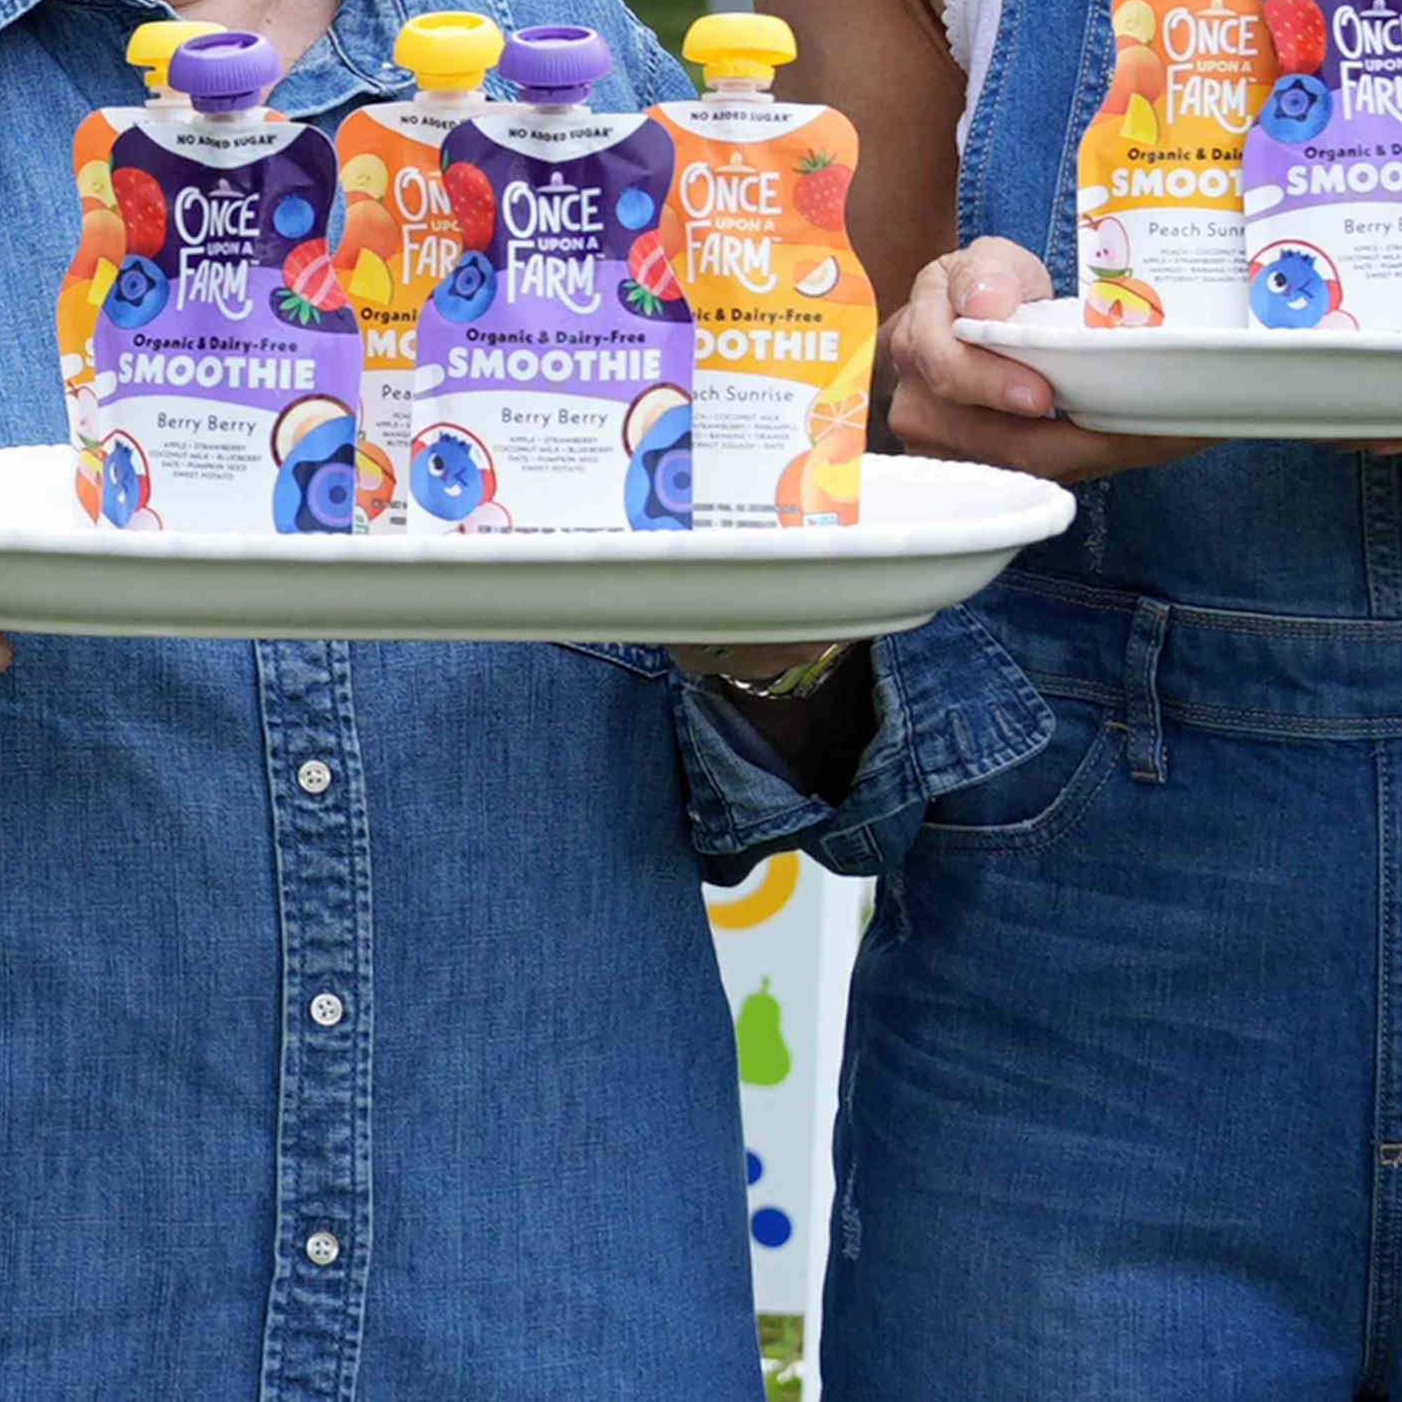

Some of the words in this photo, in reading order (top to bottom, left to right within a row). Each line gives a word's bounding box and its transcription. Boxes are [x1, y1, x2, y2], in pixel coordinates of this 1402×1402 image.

[1162, 7, 1259, 62] ONCE
[1197, 59, 1239, 72] UPON
[1241, 60, 1252, 72] A
[400, 115, 418, 125] NO
[690, 112, 709, 121] NO
[712, 111, 747, 122] ADDED
[177, 134, 195, 145] NO
[509, 128, 526, 139] NO
[1127, 148, 1191, 163] Organic
[1196, 148, 1207, 160] &
[1304, 144, 1371, 162] Organic
[1377, 144, 1387, 157] &
[679, 161, 783, 219] ONCE
[1111, 167, 1246, 199] SMOOT
[394, 166, 452, 222] ON
[174, 186, 260, 245] ONCE
[501, 180, 604, 238] ONCE
[714, 217, 761, 232] UPON
[764, 219, 776, 231] A
[1149, 222, 1201, 238] Peach
[1206, 222, 1245, 238] Sunr
[1344, 218, 1392, 236] Berry
[206, 243, 242, 256] UPON
[242, 241, 254, 255] A
[537, 237, 584, 251] UPON
[585, 236, 598, 250] A
[402, 223, 462, 285] FAR
[361, 307, 417, 324] Organi
[715, 307, 726, 322] &
[731, 307, 823, 325] Dairy-Free
[133, 333, 193, 352] Organic
[197, 336, 206, 348] &
[209, 337, 298, 353] Dairy-Free
[466, 327, 533, 345] Organic
[540, 330, 549, 344] &
[556, 330, 646, 347] Dairy-Free
[694, 328, 841, 362] OOTHIE
[118, 353, 316, 390] SMOOTHIE
[447, 347, 662, 382] SMOOTHIE
[381, 383, 412, 400] Pea
[726, 386, 795, 403] Sunrise
[157, 411, 201, 433] Berry
[208, 414, 257, 436] Berry
[501, 408, 551, 428] Berry
[558, 409, 609, 428] Berry
